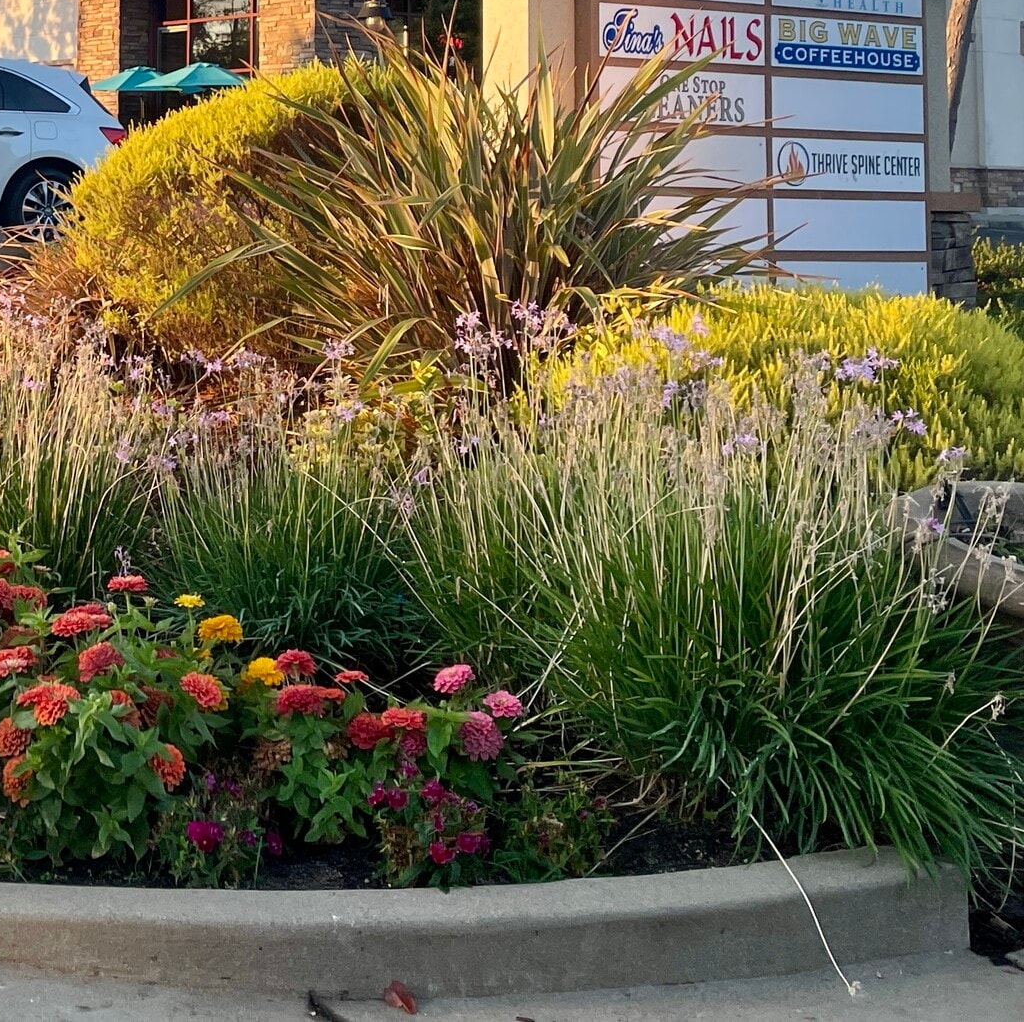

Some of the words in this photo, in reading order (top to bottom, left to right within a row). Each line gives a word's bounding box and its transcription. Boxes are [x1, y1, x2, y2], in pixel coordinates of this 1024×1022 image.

[603, 8, 665, 55] Tina's
[670, 12, 763, 62] NAILS
[778, 18, 829, 43] BIG
[837, 22, 917, 50] WAVE
[781, 46, 915, 68] COFFEEHOUSE
[811, 153, 848, 174] THRIVE
[851, 154, 881, 175] SPINE
[884, 155, 921, 177] CENTER
